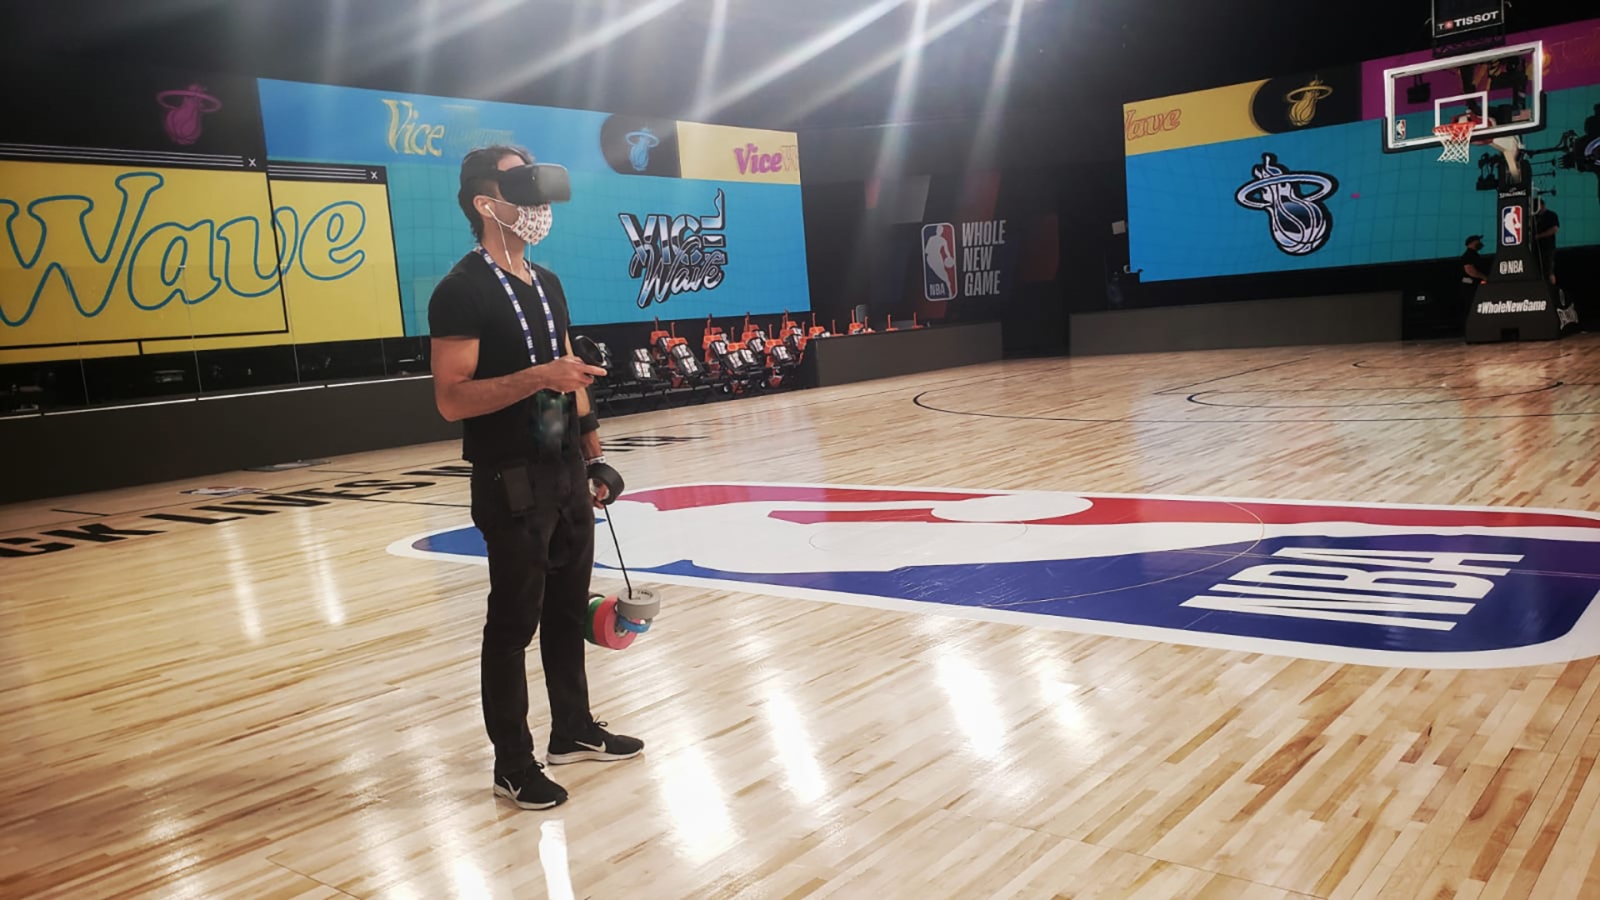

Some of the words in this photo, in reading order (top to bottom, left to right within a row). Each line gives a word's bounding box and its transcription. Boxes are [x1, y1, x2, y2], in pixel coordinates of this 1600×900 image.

[1454, 10, 1499, 28] TISSOT
[382, 98, 445, 157] Vice
[733, 143, 782, 175] Vice
[962, 220, 1006, 247] WHOLE
[0, 171, 366, 327] Wave
[963, 245, 993, 272] NEW
[1500, 260, 1523, 274] @NBA
[929, 282, 946, 296] NBA
[964, 270, 1001, 297] GAME
[1477, 299, 1547, 314] #WholeNewGame
[140, 479, 436, 525] LIVES
[1178, 547, 1526, 631] NBA
